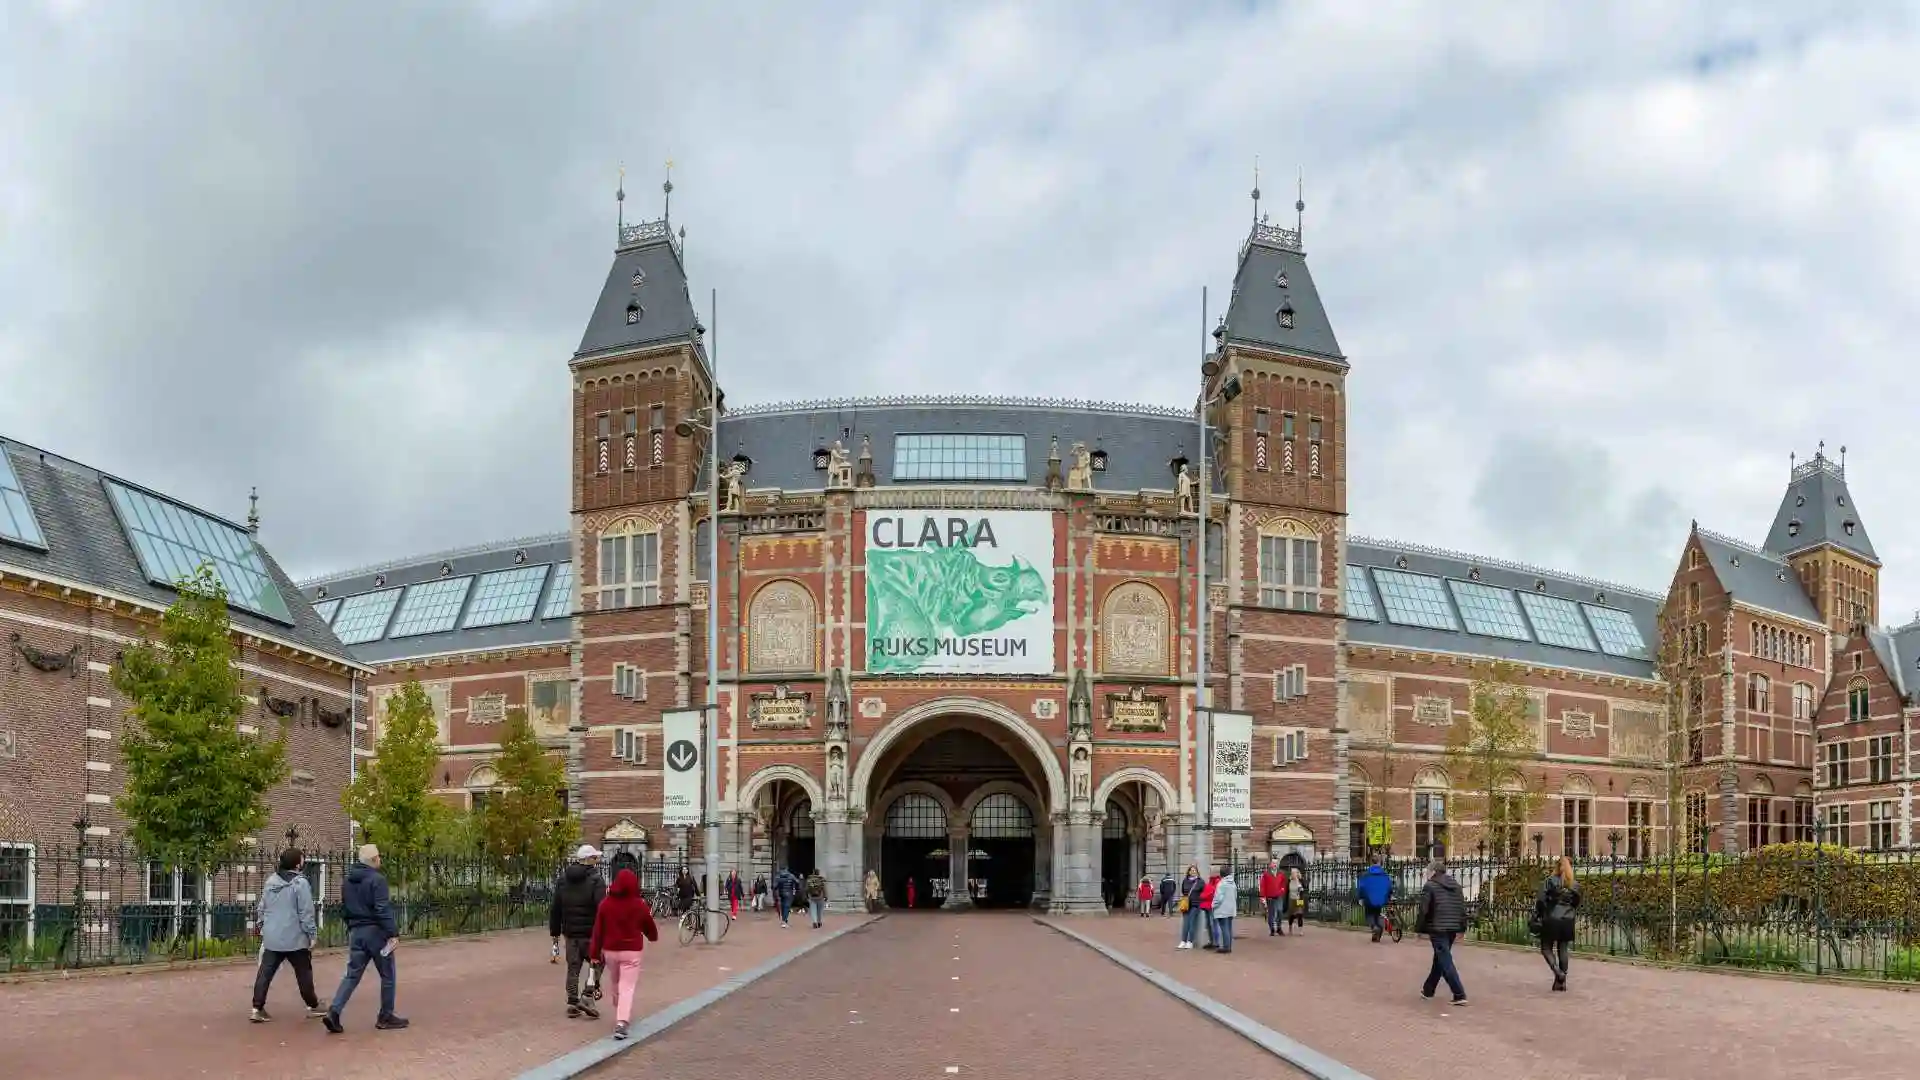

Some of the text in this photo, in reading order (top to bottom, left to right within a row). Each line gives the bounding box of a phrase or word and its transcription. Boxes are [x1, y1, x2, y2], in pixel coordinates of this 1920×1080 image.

[872, 517, 997, 548] CLARA
[872, 638, 1027, 657] RIJKS MUSEUM
